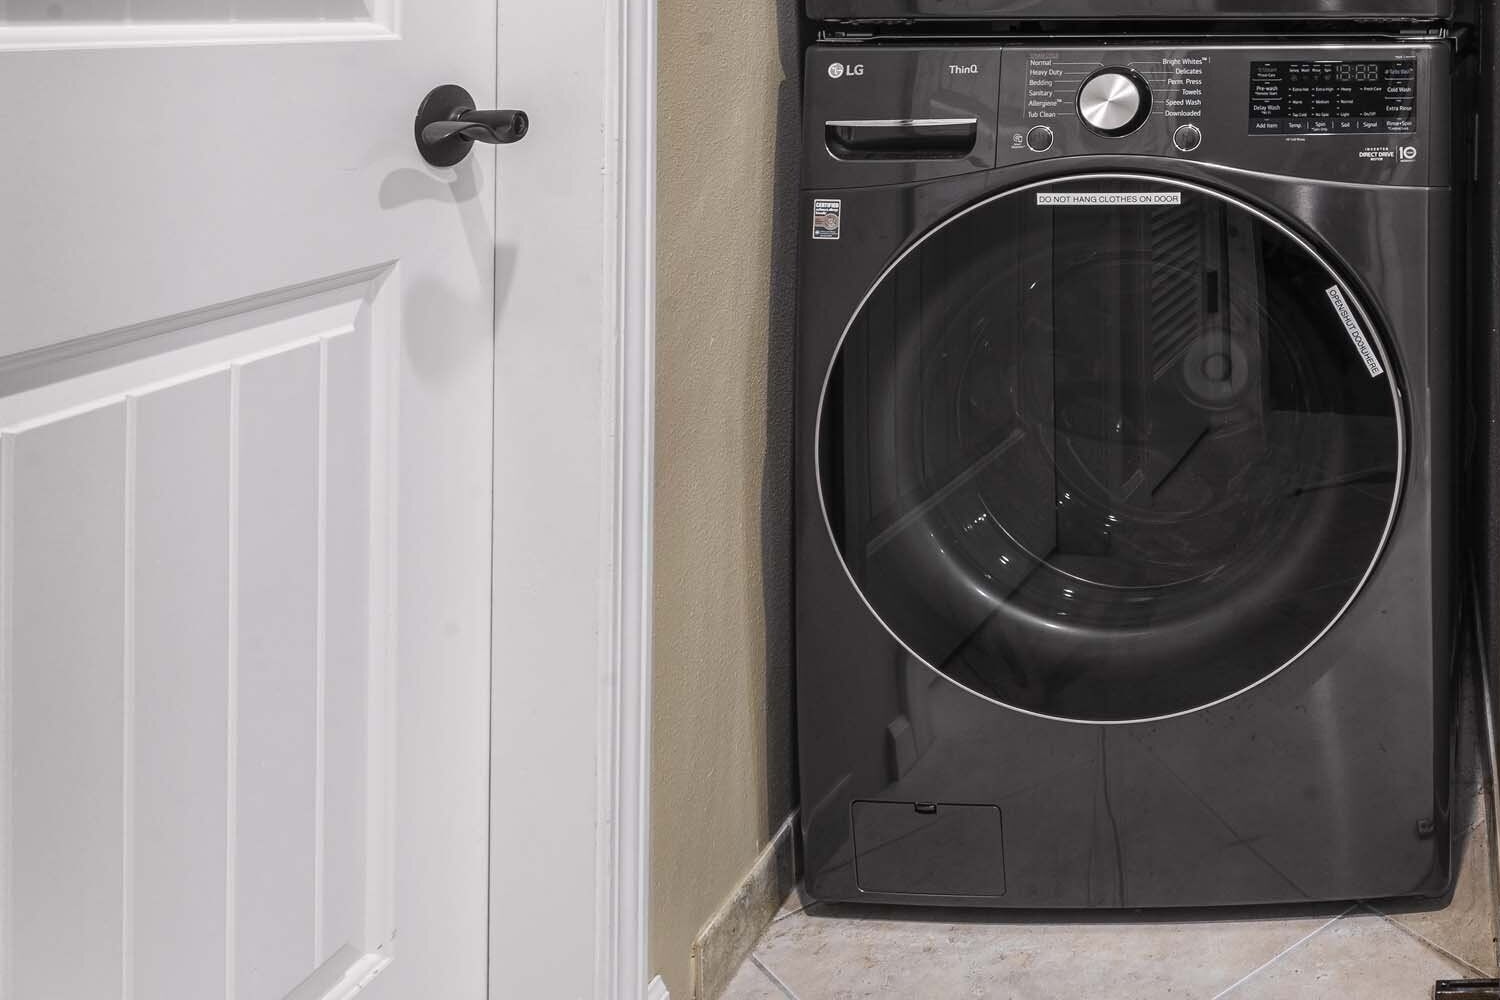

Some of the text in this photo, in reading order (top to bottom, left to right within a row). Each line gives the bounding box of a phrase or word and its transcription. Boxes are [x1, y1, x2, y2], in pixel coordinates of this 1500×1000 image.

[1162, 58, 1181, 67] Bright
[846, 64, 864, 76] LG
[949, 64, 978, 74] ThinQ
[1165, 99, 1184, 107] Speed
[1400, 146, 1416, 159] 10
[1328, 288, 1355, 330] OPEN/SHUT
